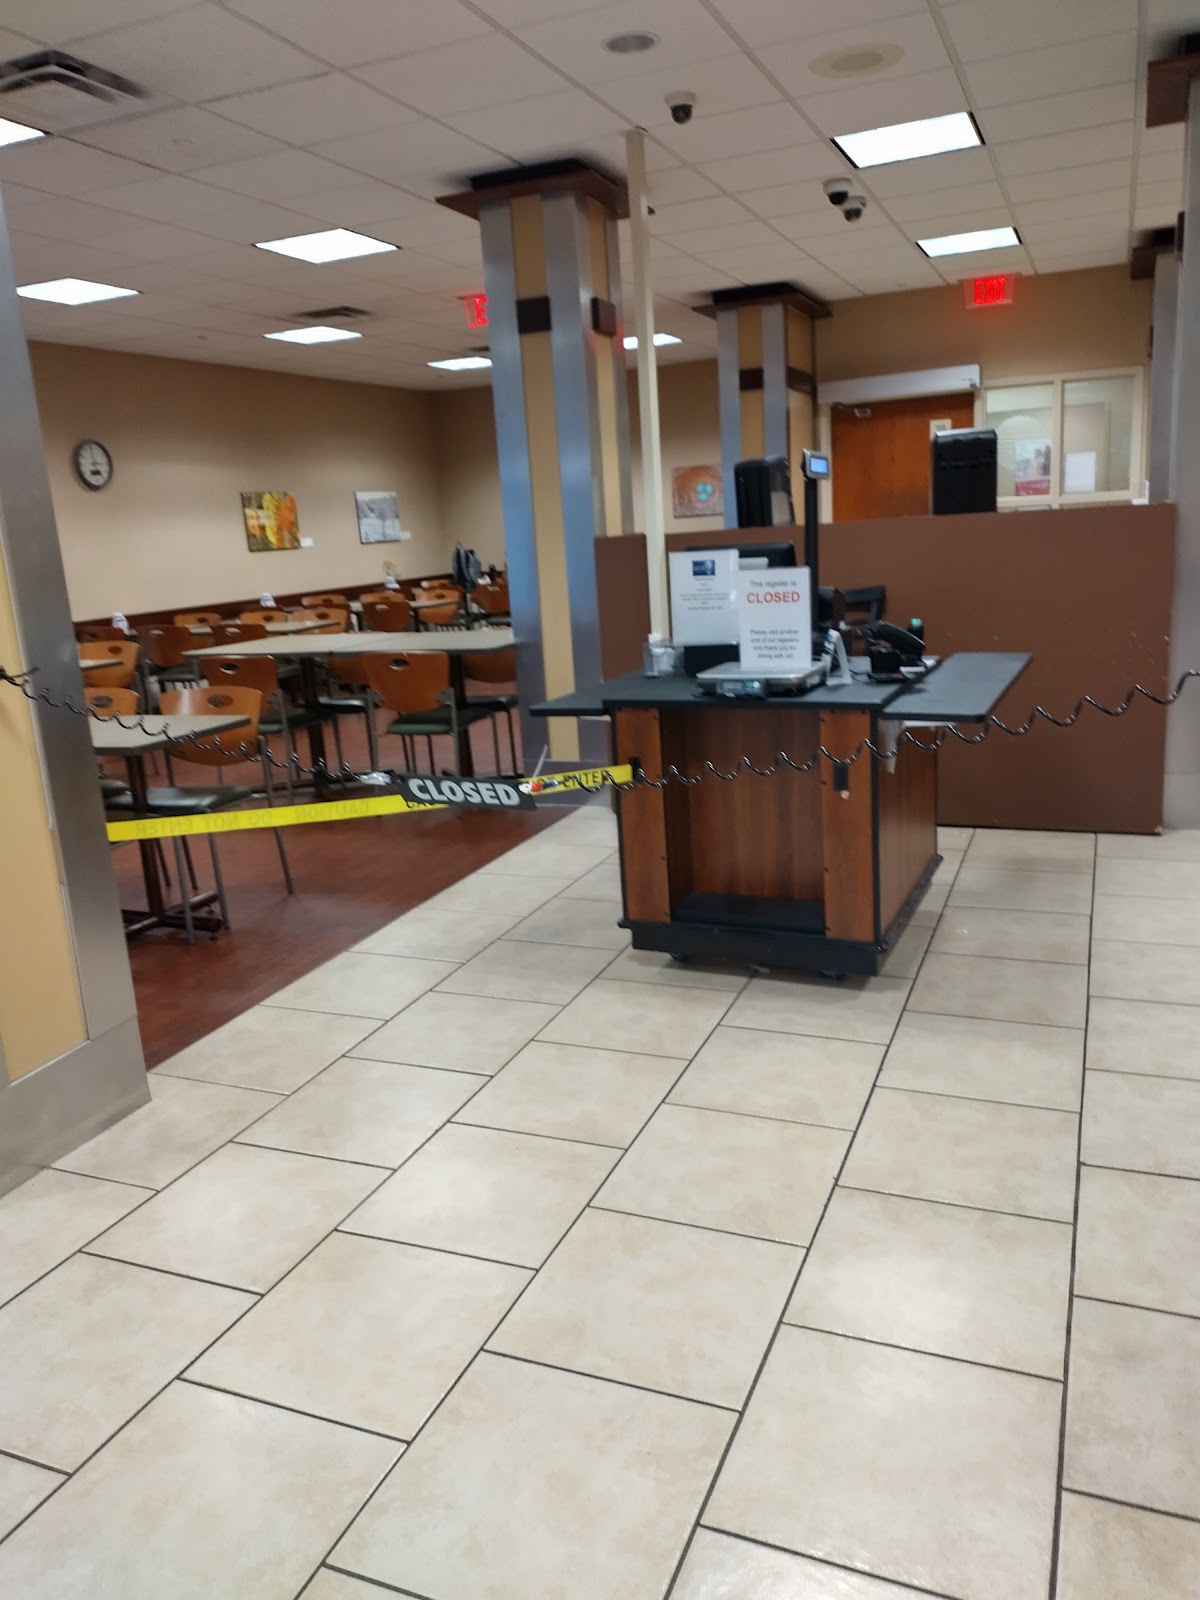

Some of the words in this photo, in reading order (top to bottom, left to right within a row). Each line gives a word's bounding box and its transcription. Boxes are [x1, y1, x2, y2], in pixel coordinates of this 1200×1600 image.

[974, 276, 1006, 305] EXIT
[750, 580, 763, 588] This
[764, 580, 789, 588] register
[790, 579, 797, 587] is
[747, 590, 800, 604] CLOSED
[408, 778, 520, 806] CLOSED
